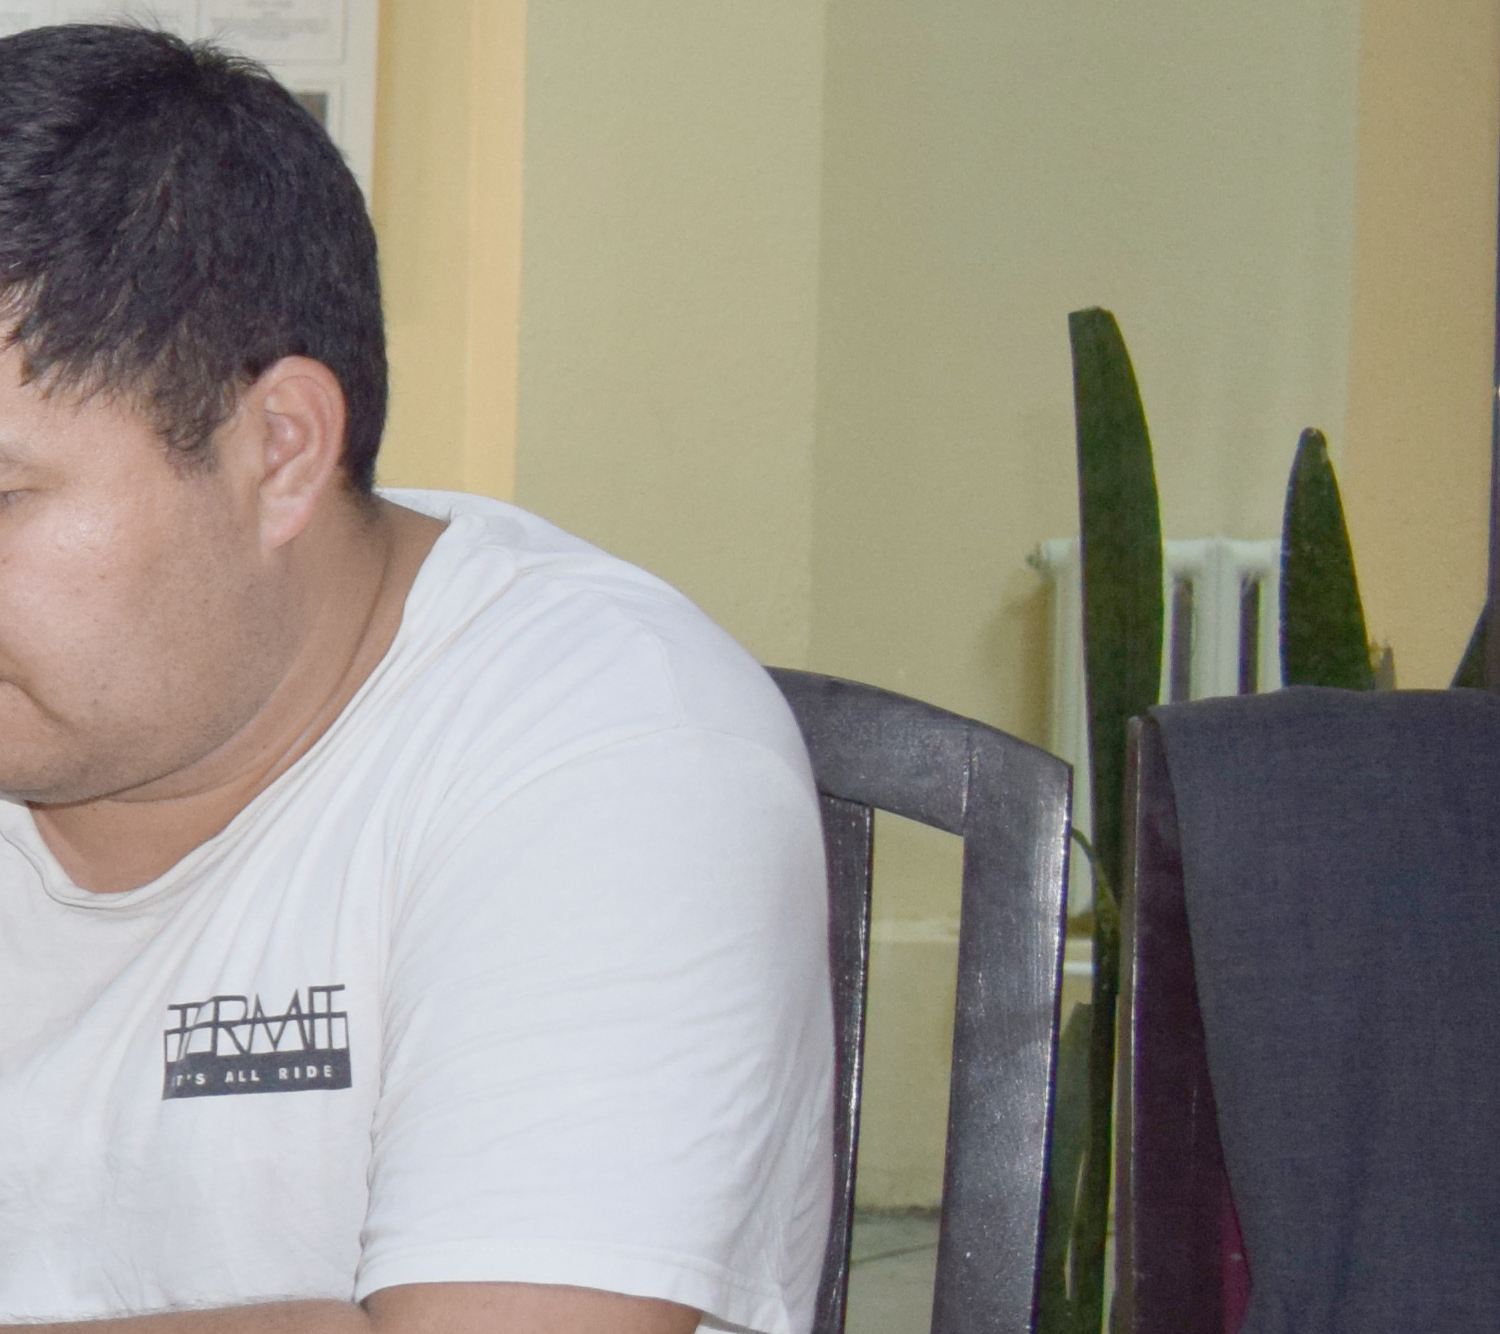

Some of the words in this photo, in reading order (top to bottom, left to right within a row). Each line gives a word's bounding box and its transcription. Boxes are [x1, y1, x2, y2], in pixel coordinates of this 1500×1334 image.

[171, 1072, 206, 1087] IT'S
[225, 1070, 260, 1083] ALL
[278, 1064, 333, 1080] RIDE
